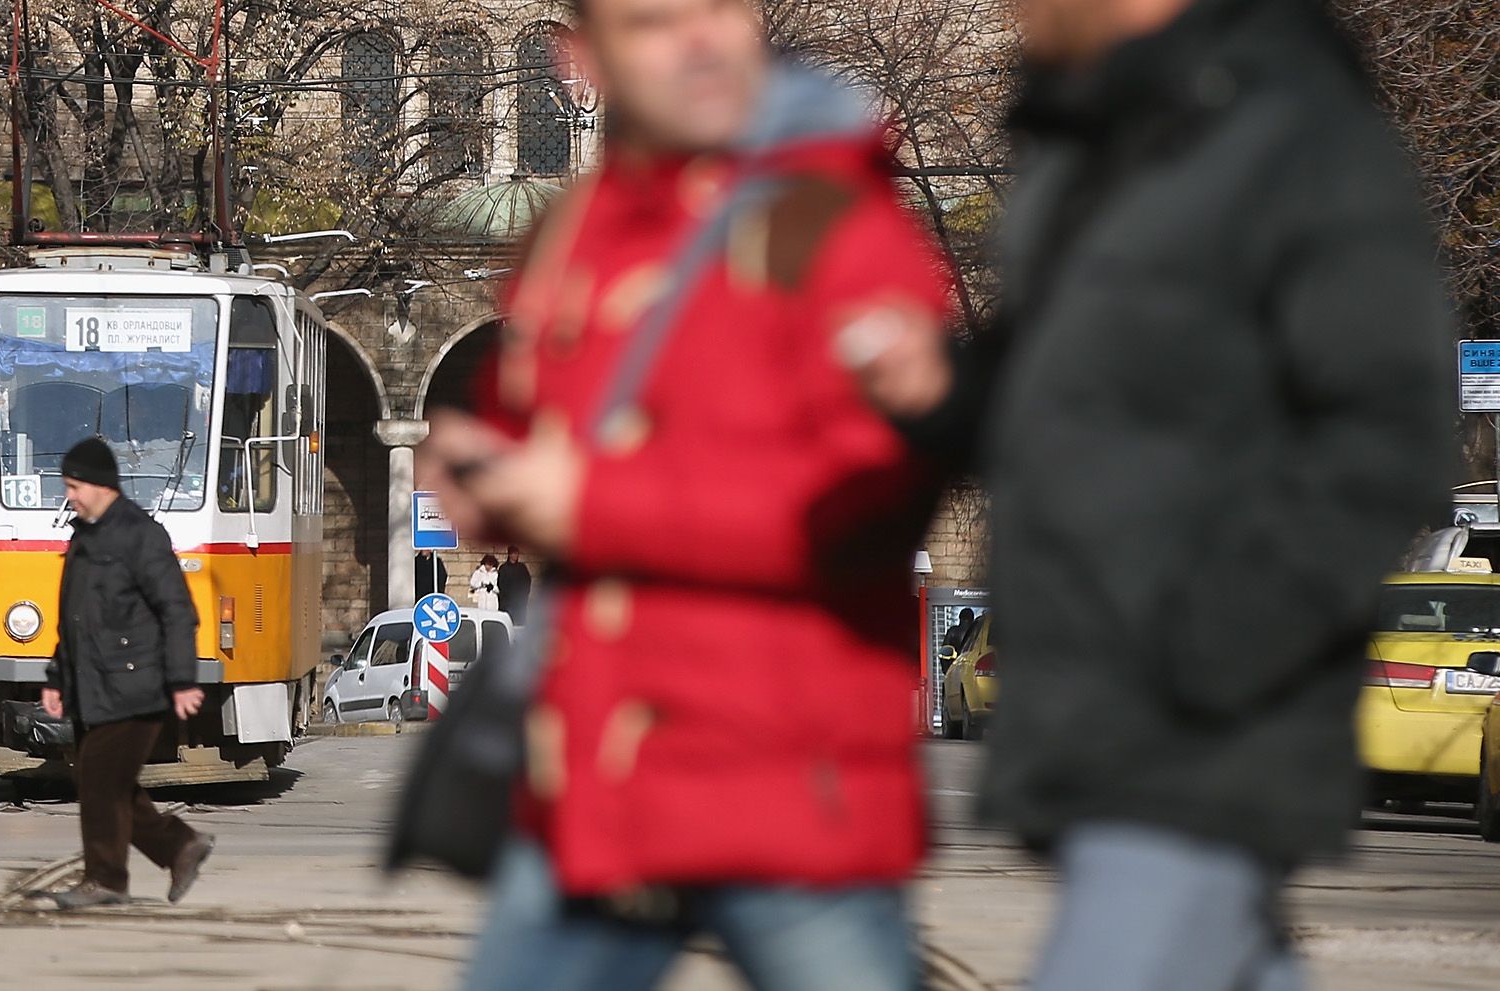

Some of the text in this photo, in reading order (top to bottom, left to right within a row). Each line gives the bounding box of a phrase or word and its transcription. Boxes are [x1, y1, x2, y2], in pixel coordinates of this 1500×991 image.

[21, 315, 42, 329] 18
[123, 320, 182, 331] ОРЛАНДОВЦИ
[75, 316, 100, 347] 18
[127, 334, 181, 344] ЖУРНАЛИСТ
[4, 480, 37, 507] 18
[1459, 560, 1482, 568] TAXI
